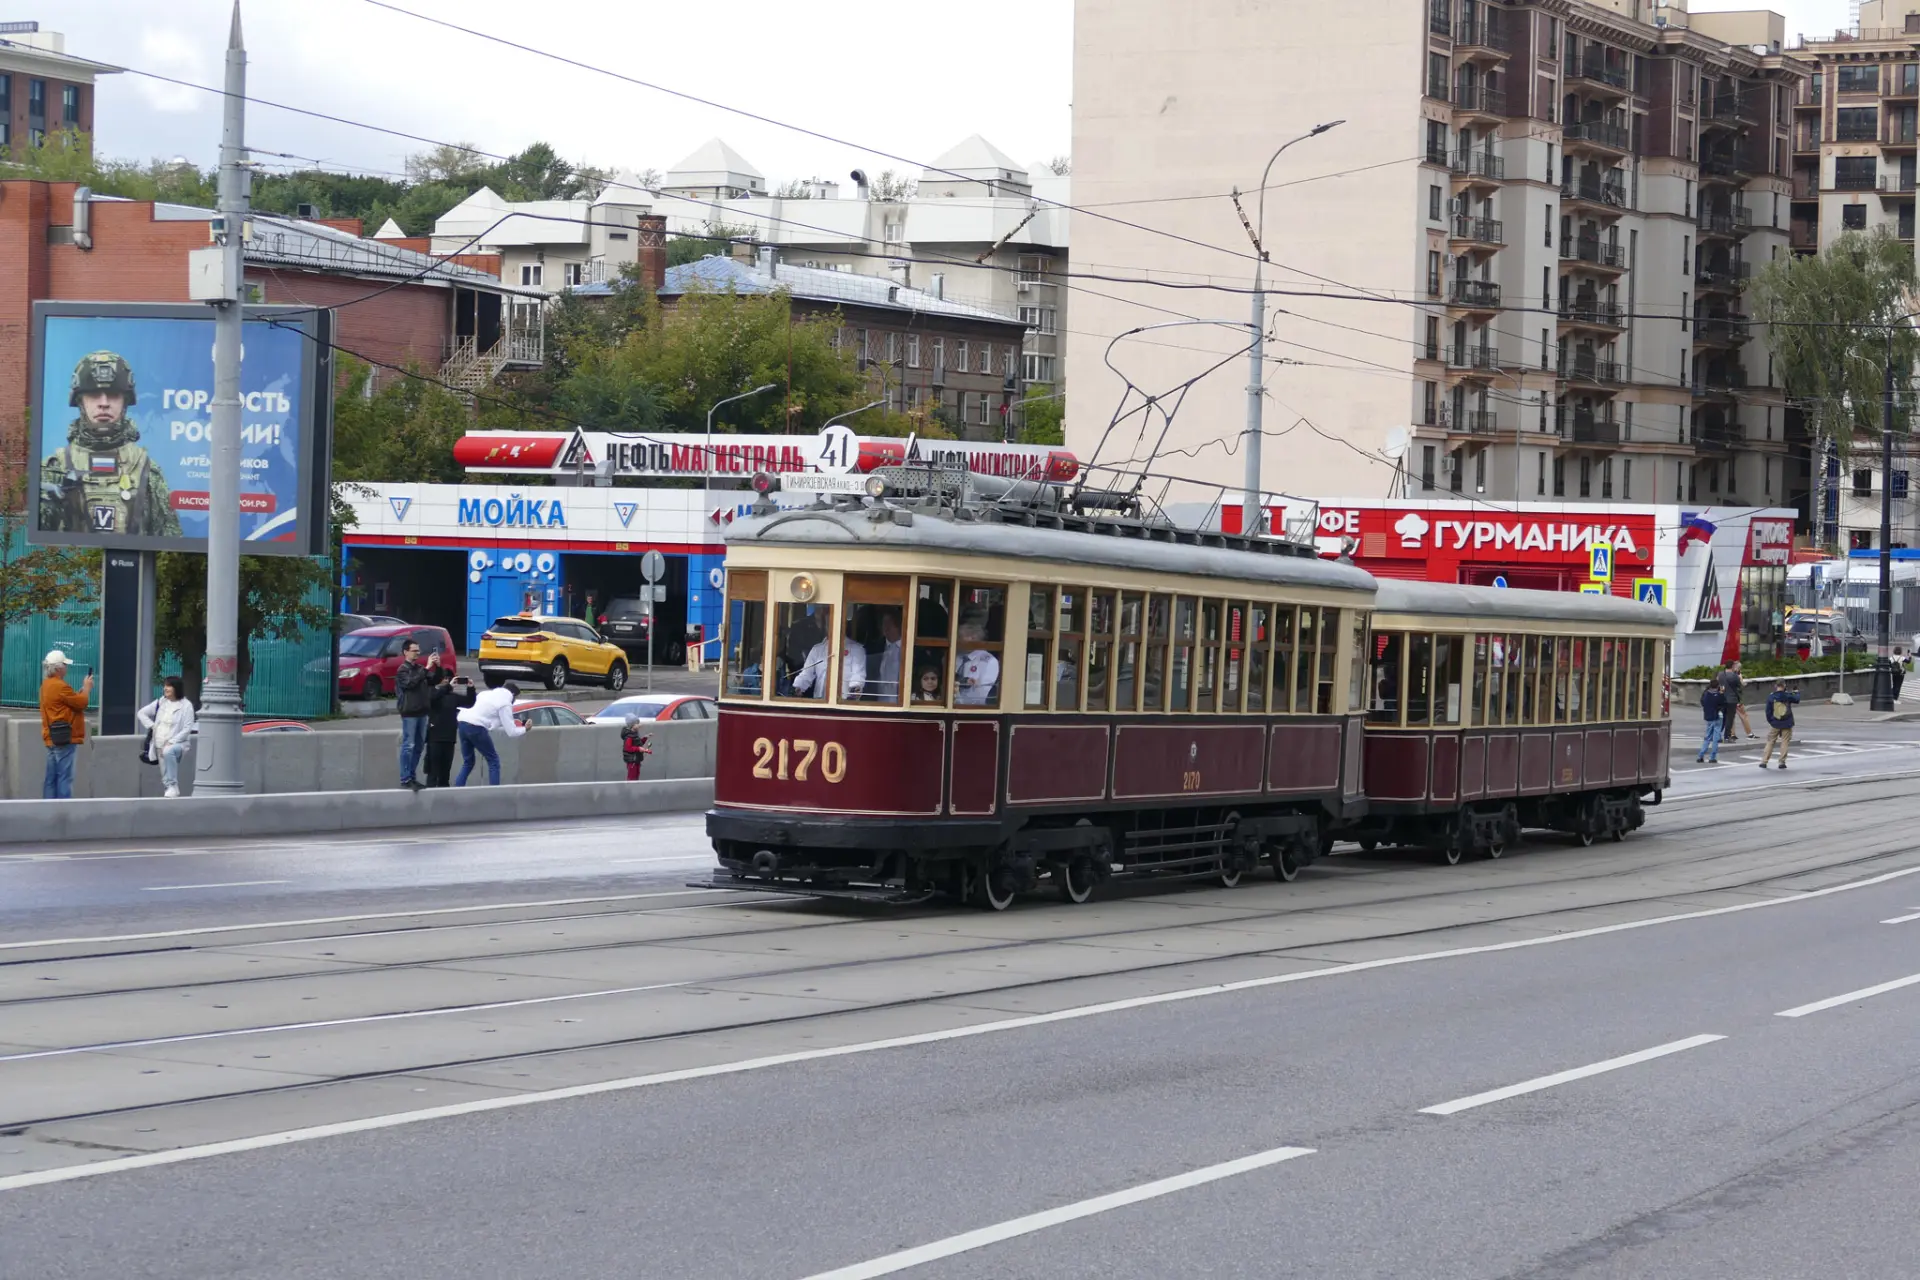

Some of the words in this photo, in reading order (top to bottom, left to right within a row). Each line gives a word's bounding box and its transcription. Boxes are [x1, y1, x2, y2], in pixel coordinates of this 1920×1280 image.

[163, 389, 290, 413] ГОРСТЬ
[170, 421, 281, 445] РОИИ!
[819, 433, 848, 468] 41
[97, 509, 112, 527] V
[458, 493, 566, 527] МОЙКА
[622, 507, 628, 516] 2
[1434, 520, 1637, 554] ГУРМАНИКА
[753, 737, 847, 783] 2170
[1183, 771, 1200, 790] 2170
